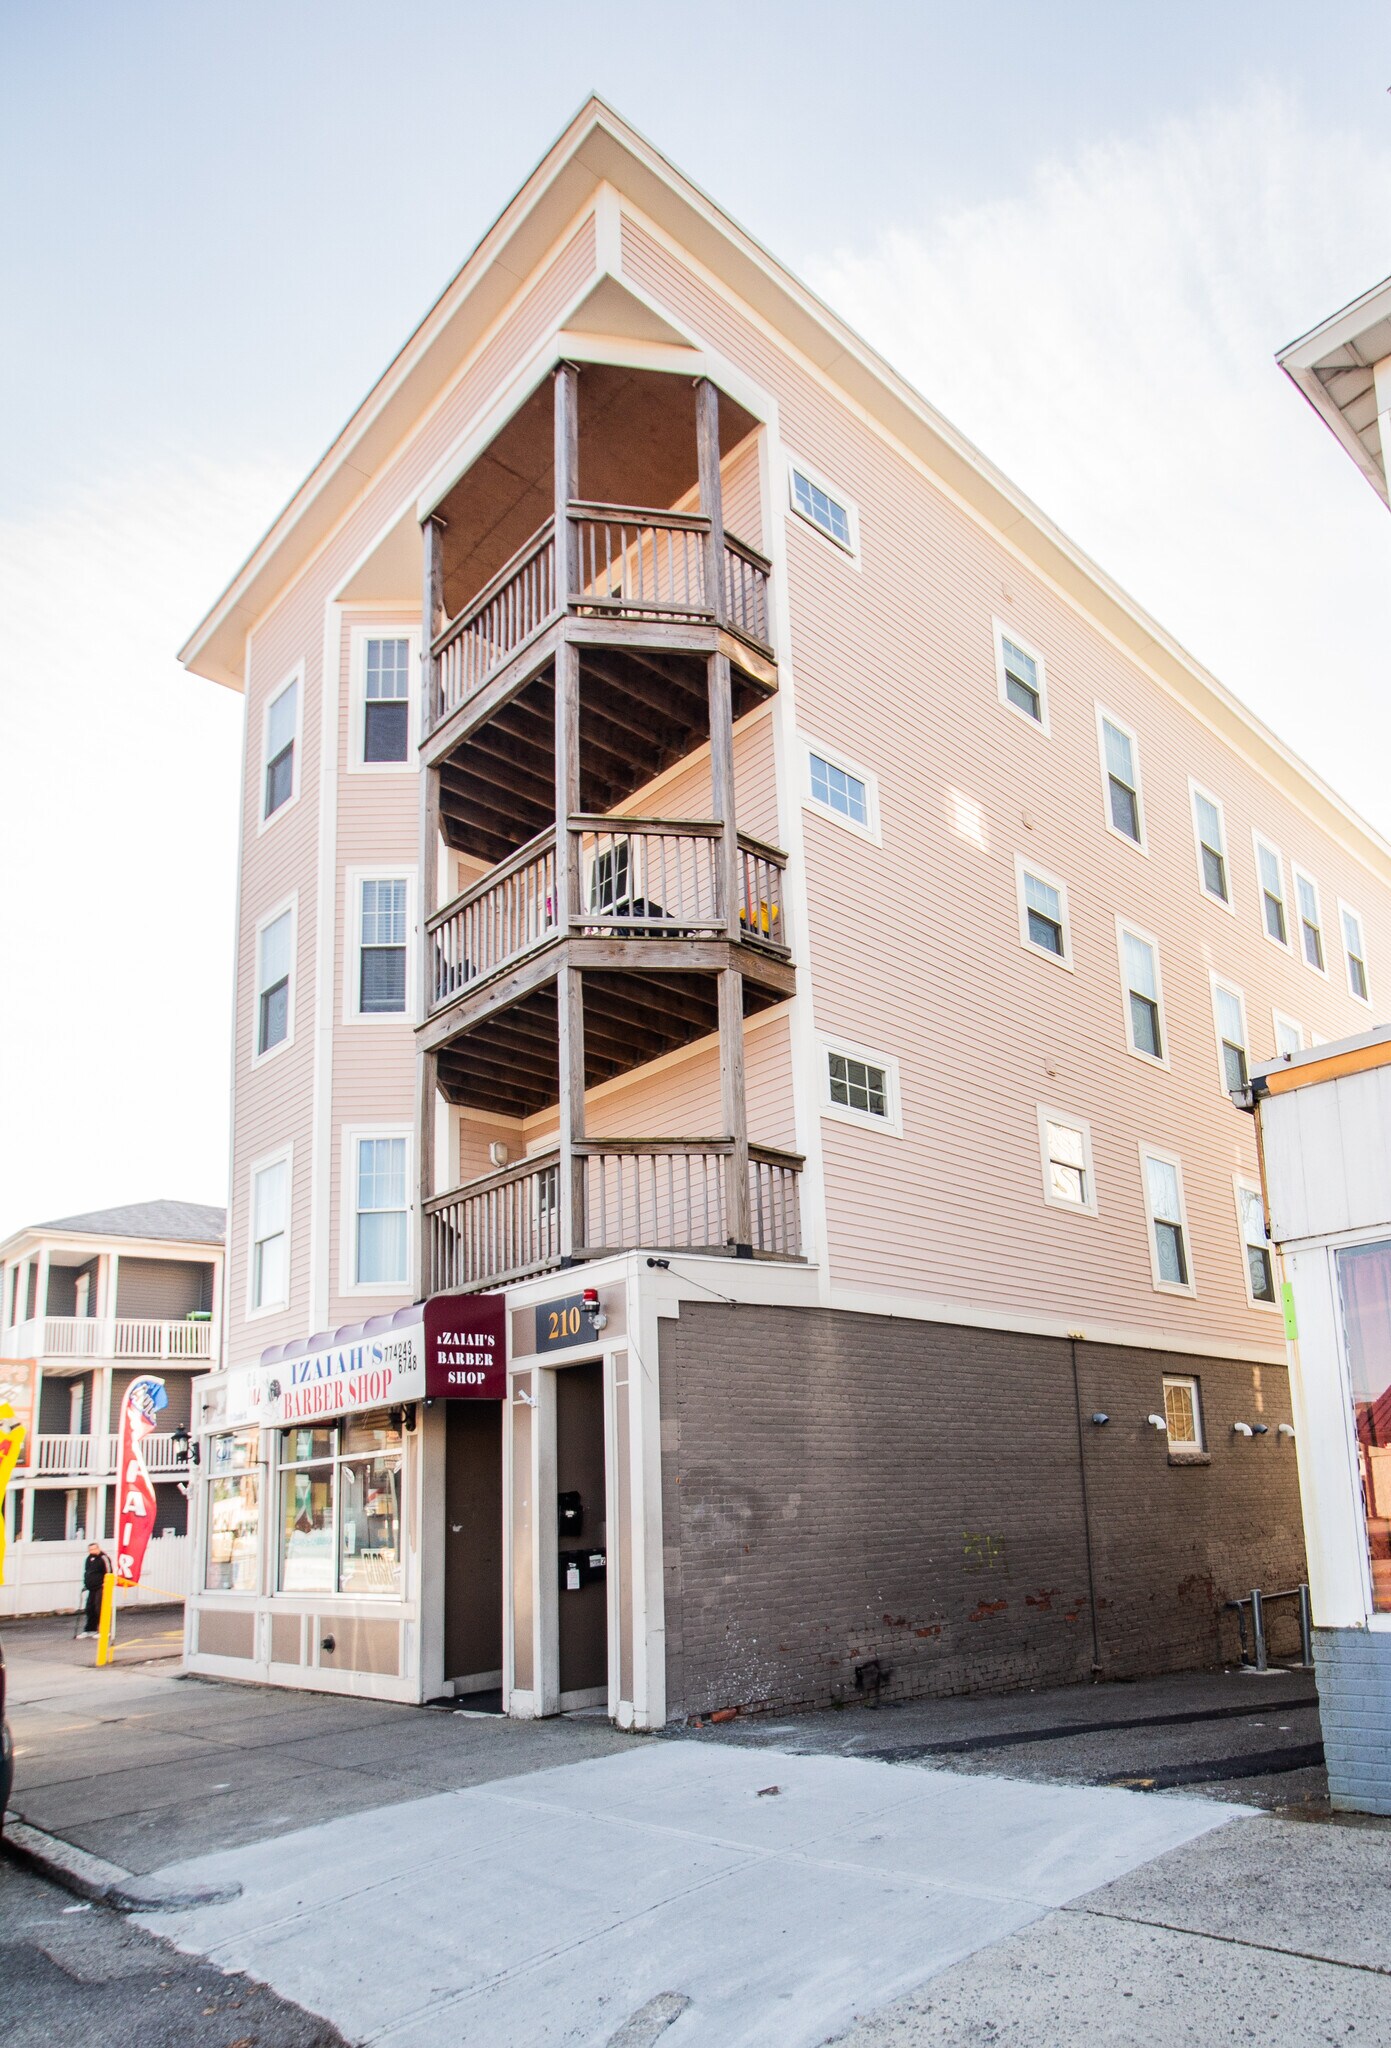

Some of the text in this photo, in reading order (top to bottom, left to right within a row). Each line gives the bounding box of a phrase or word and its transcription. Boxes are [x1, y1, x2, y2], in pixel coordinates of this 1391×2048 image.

[548, 1306, 581, 1339] 210
[291, 1341, 383, 1385] IZAIAH'S
[398, 1355, 417, 1374] 6748
[437, 1351, 494, 1366] BARBER
[448, 1371, 486, 1384] SHOP
[284, 1380, 344, 1419] BARBER
[349, 1368, 392, 1405] SHOP
